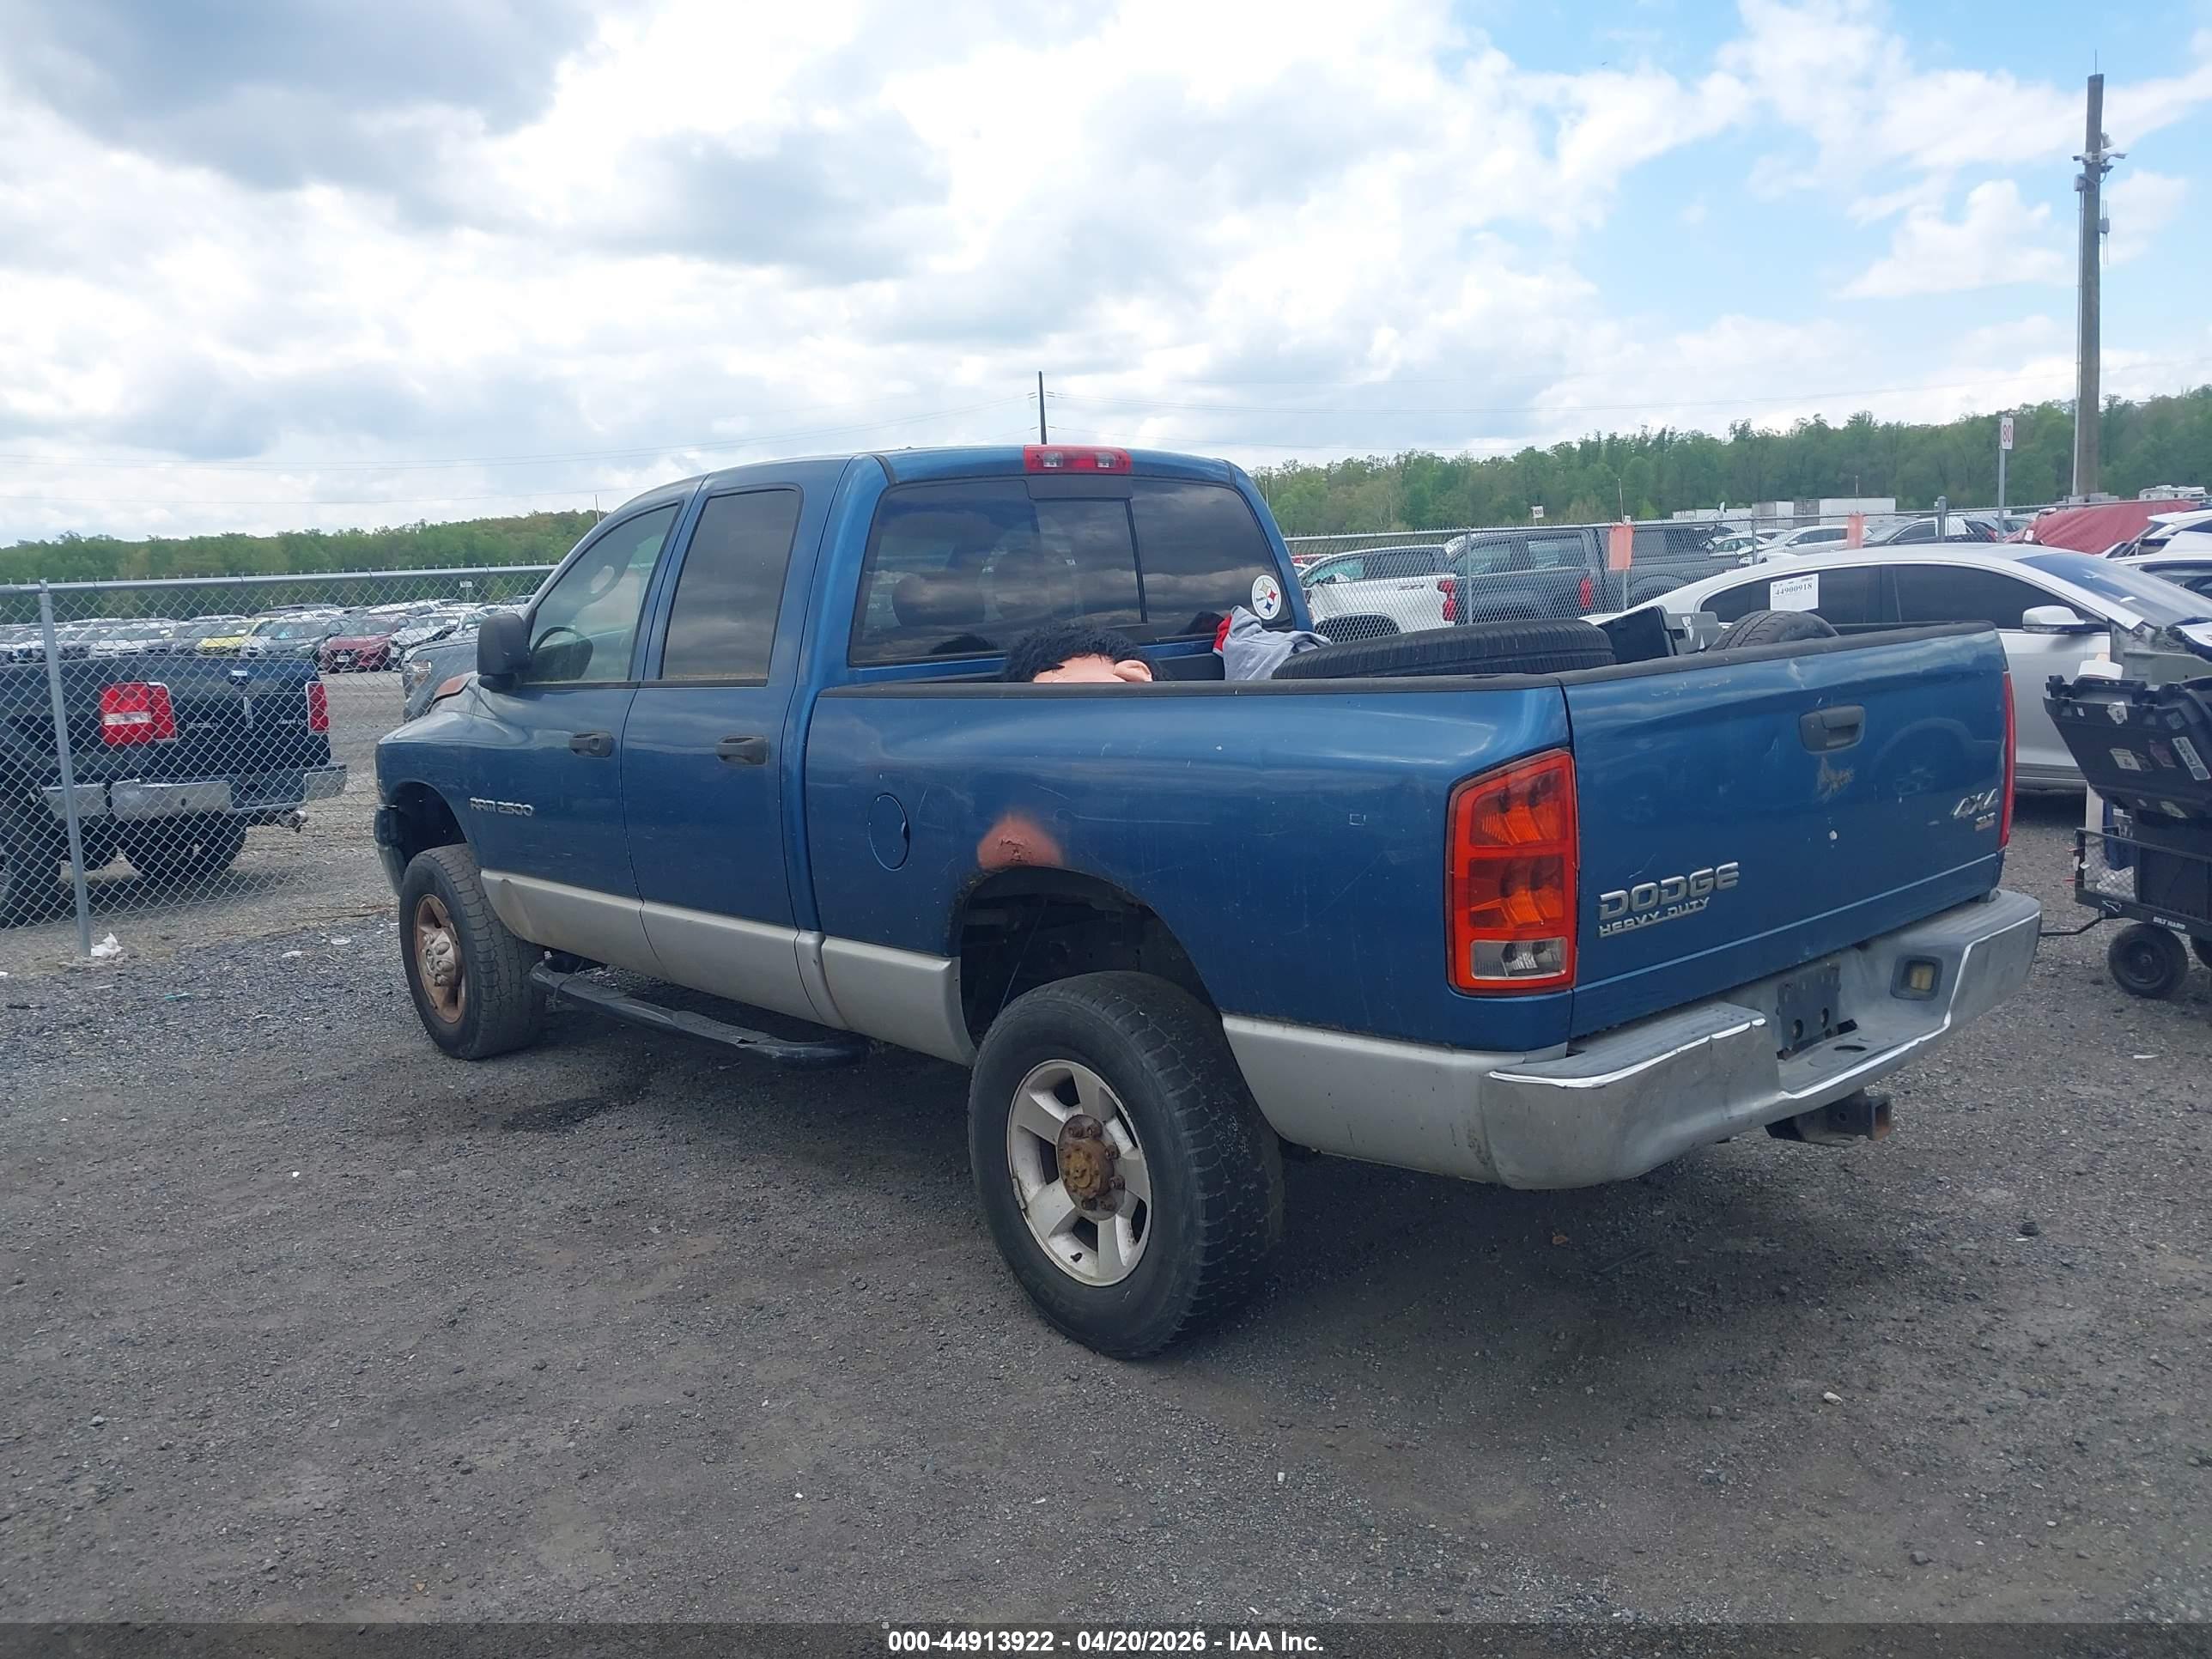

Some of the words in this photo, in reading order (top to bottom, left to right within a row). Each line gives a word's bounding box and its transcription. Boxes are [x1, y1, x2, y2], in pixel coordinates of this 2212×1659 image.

[2002, 424, 2012, 443] 80
[1774, 582, 1814, 595] 44900918
[469, 796, 496, 813] RAM
[496, 800, 534, 817] 2500
[1599, 861, 1740, 921] DODGE
[1599, 910, 1660, 939] HEAVY
[1667, 896, 1711, 916] DUTY
